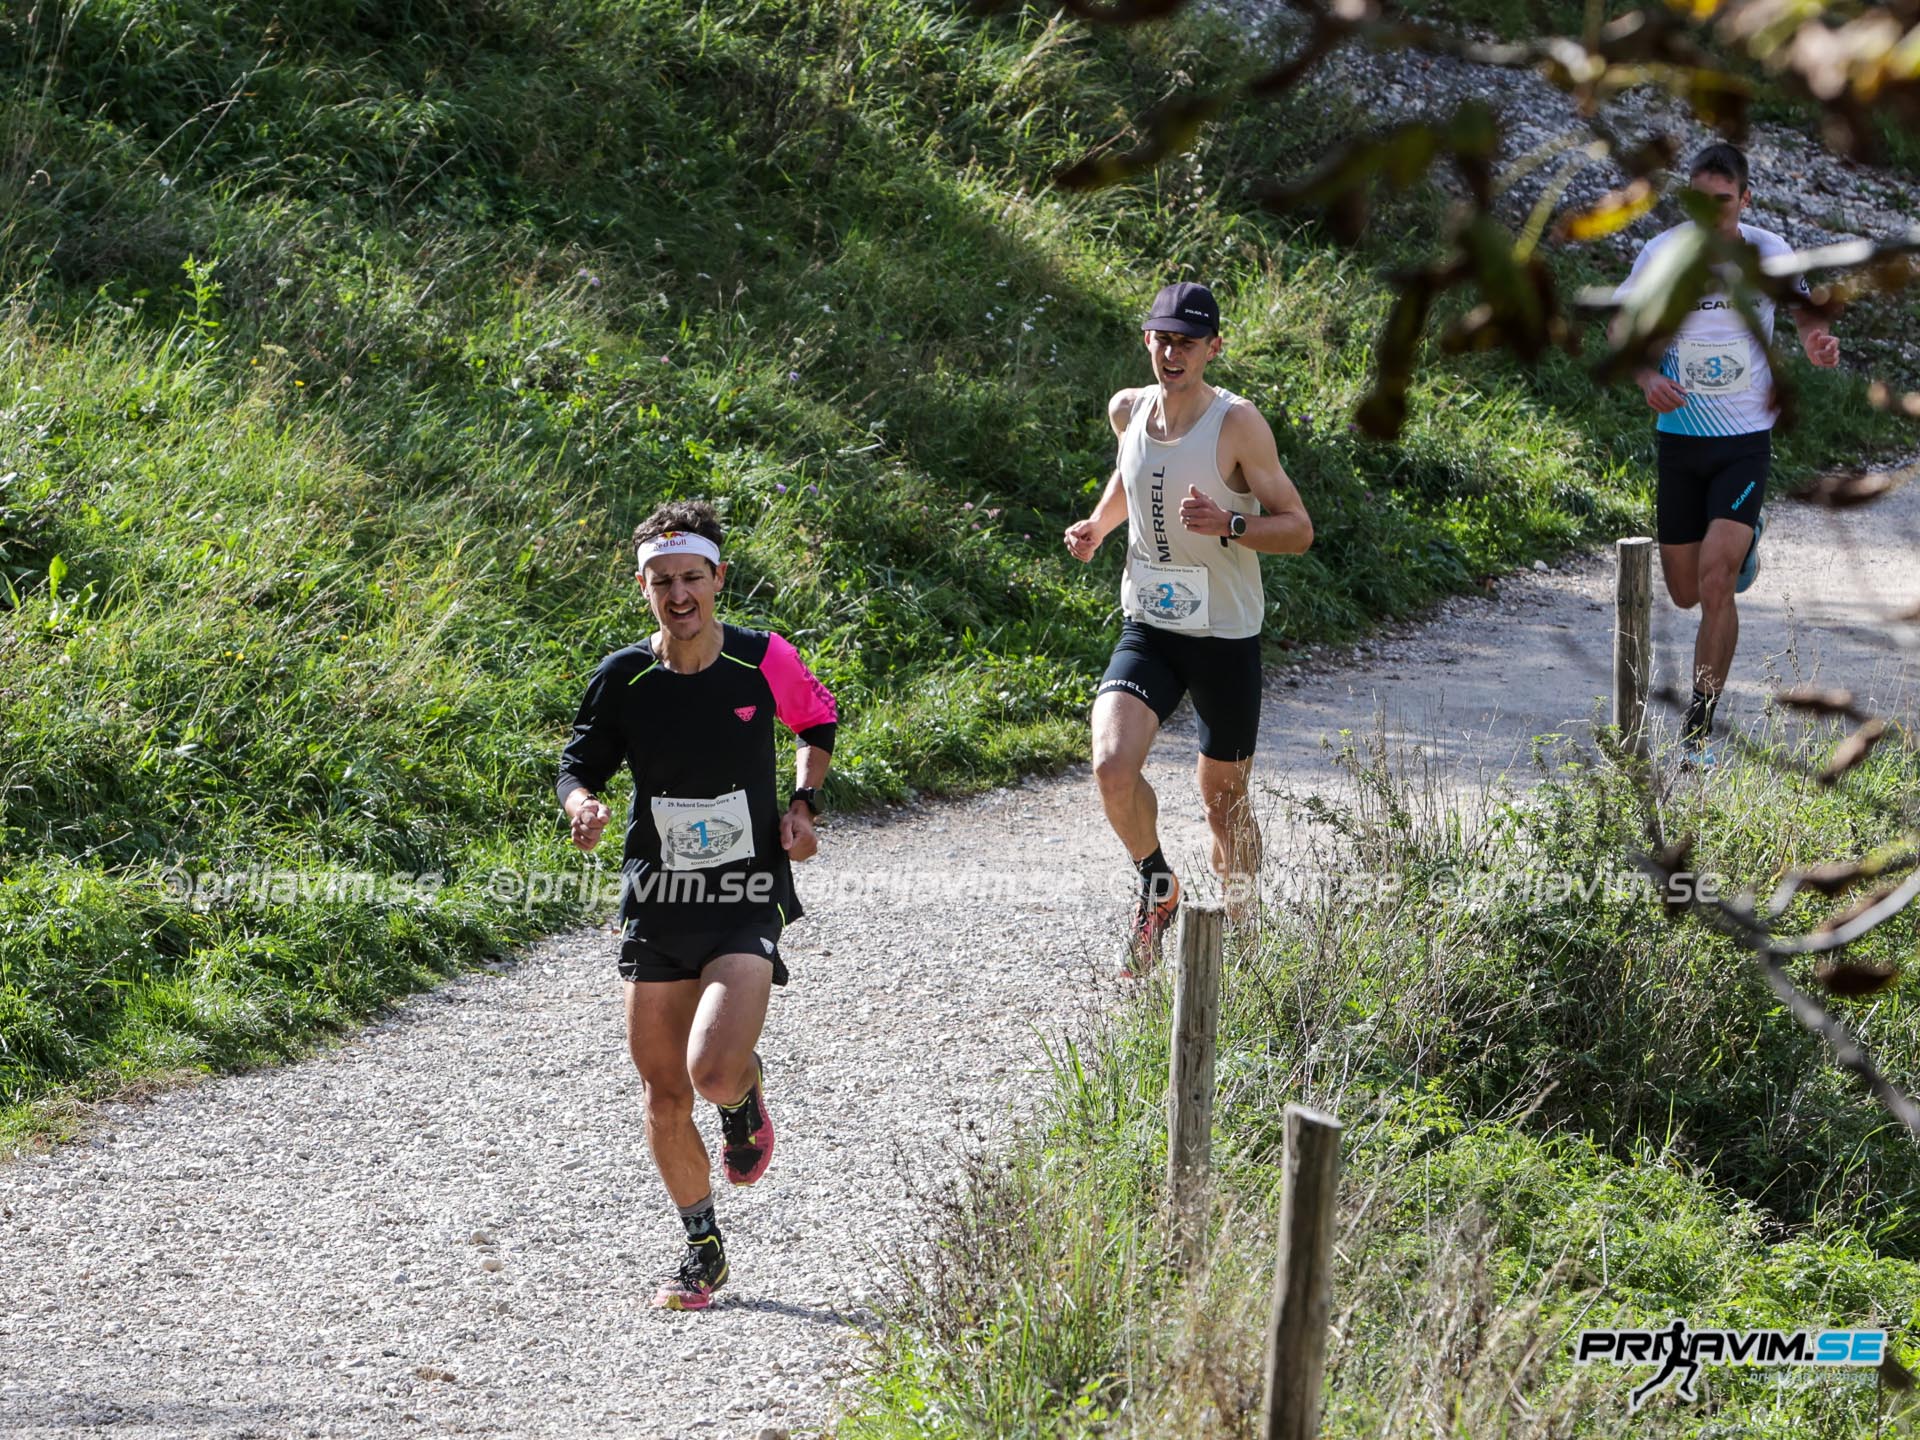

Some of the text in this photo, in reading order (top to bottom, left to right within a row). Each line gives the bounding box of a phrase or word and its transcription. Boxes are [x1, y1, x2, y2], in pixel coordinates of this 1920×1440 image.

[1707, 356, 1722, 379] 3
[1152, 465, 1172, 562] MERRELL
[670, 538, 687, 547] Bull
[1158, 583, 1175, 608] 2
[689, 821, 710, 848] 1
